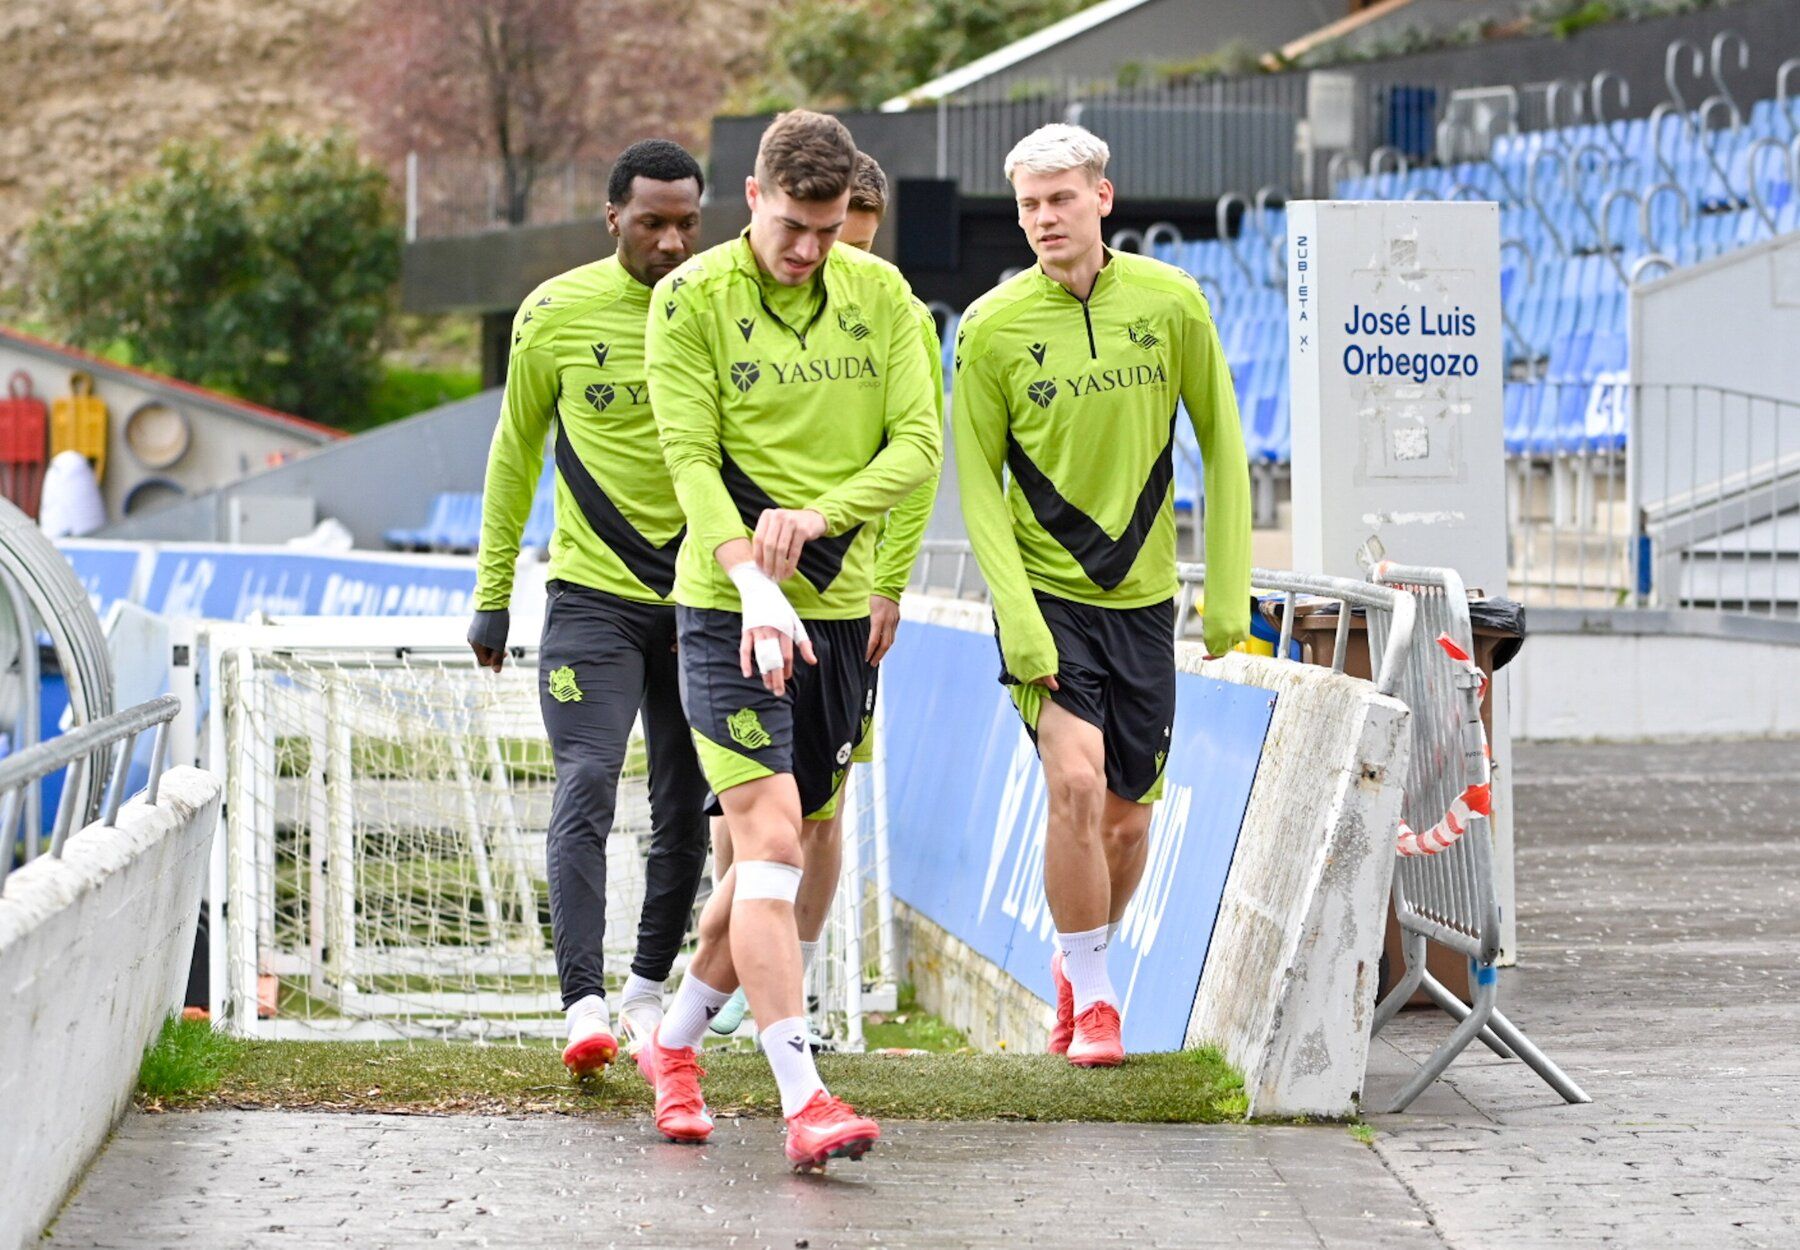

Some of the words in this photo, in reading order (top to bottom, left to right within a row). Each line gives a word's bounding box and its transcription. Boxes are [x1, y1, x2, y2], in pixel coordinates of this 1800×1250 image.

[1297, 235, 1308, 321] ZUBIETA
[1344, 304, 1411, 336] José
[1420, 305, 1476, 337] Luis
[770, 356, 879, 385] YASUDA
[1065, 363, 1167, 398] YASUDA
[1342, 344, 1479, 384] Orbegozo
